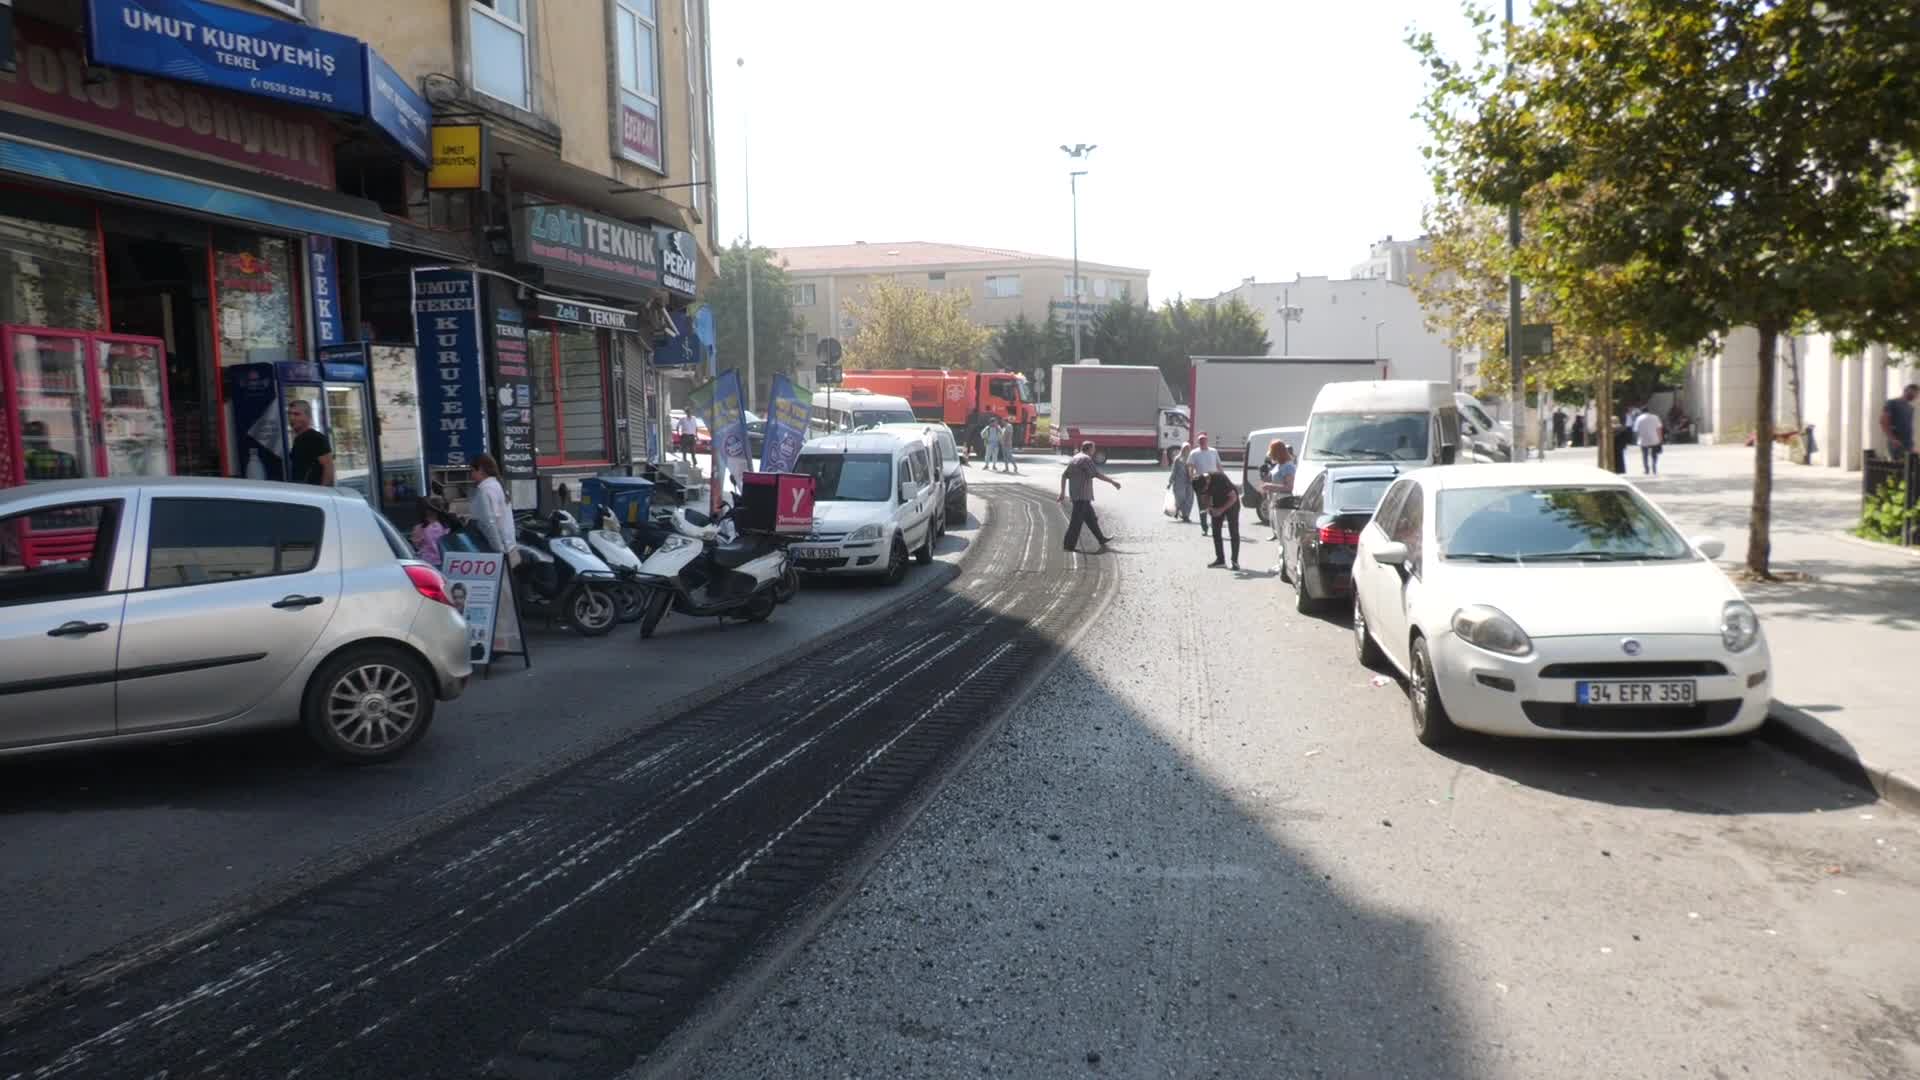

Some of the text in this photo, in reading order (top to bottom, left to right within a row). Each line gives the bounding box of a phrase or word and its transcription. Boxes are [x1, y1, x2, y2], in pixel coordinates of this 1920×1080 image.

[123, 8, 336, 77] UMUT KURUYEMİŞ
[216, 51, 260, 71] TEKEL
[531, 206, 583, 247] Zeki
[416, 280, 469, 294] UMUT
[312, 253, 334, 341] TEKE
[416, 297, 475, 312] TEKEL
[556, 304, 579, 320] Zeki
[448, 560, 497, 576] FOTO
[1591, 683, 1692, 702] 34 EFR 358
